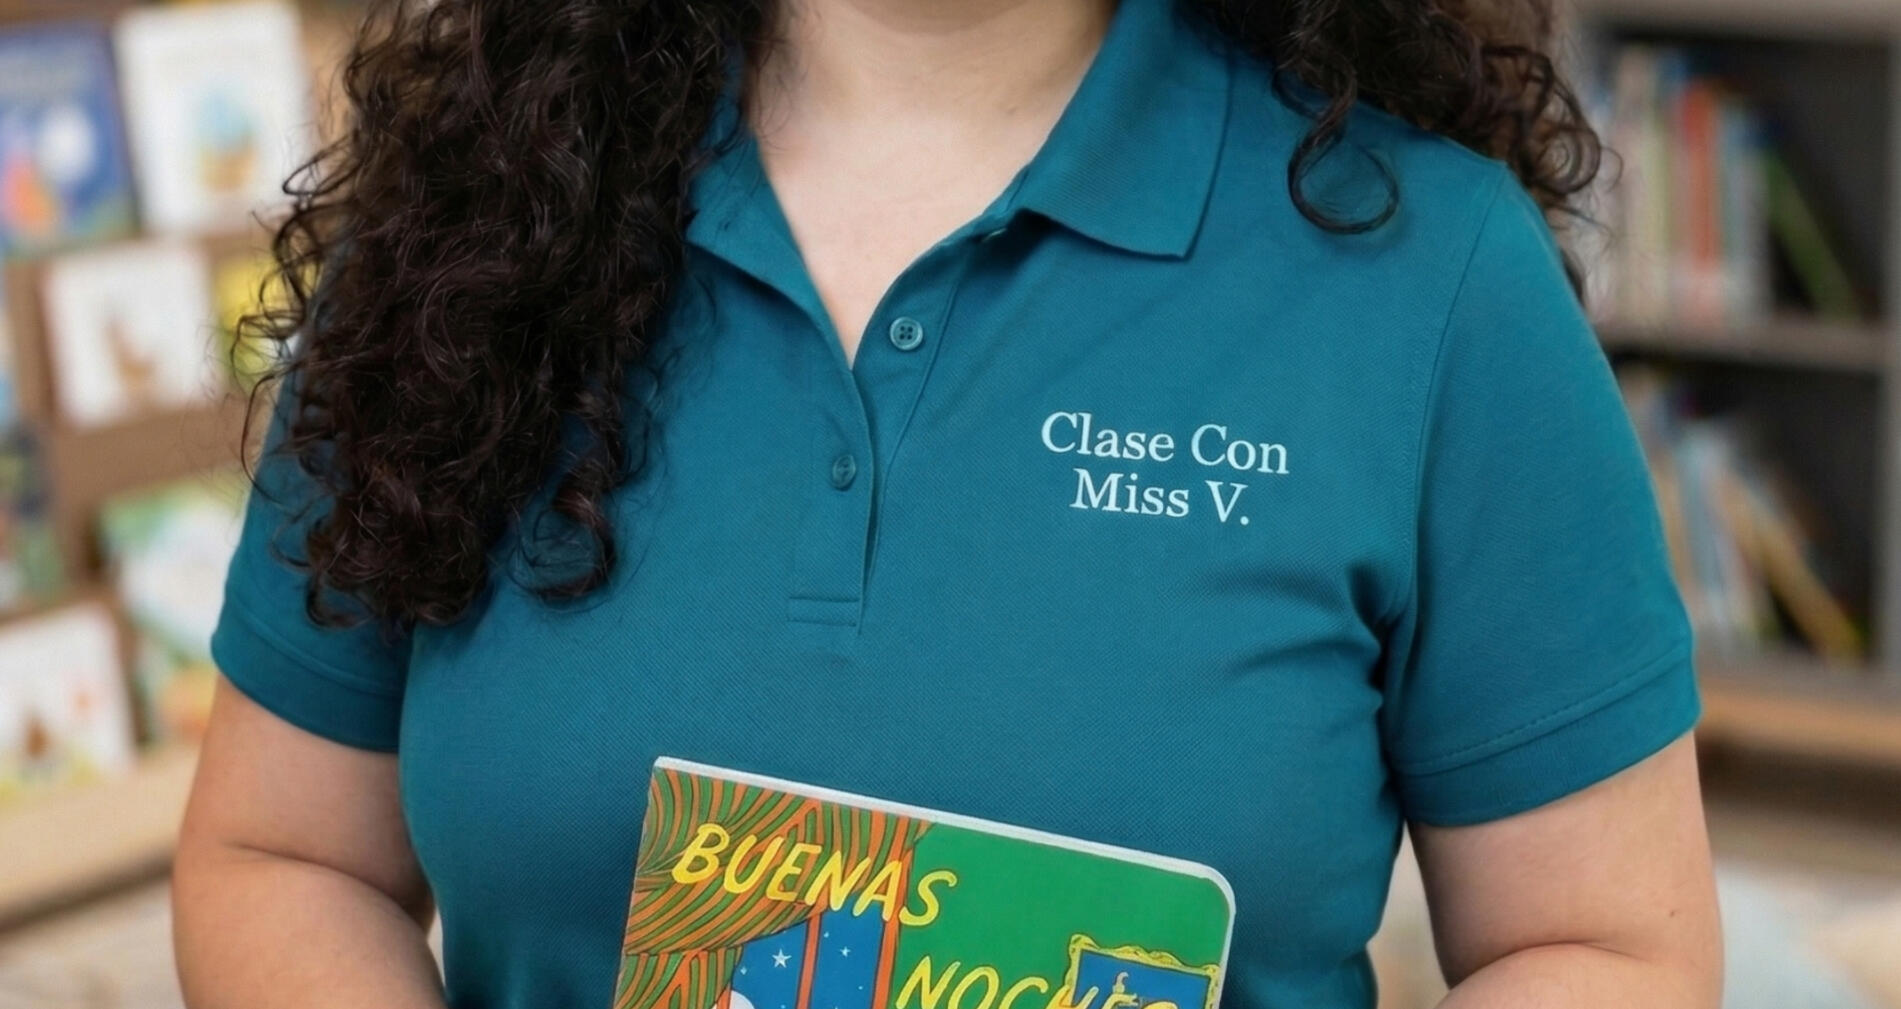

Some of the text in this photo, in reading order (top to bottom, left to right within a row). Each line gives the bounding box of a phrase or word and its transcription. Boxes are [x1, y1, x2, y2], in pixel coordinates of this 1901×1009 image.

[1041, 411, 1290, 475] Clase Con
[1069, 468, 1250, 526] Miss V.
[671, 823, 958, 927] BUENAS
[896, 955, 1178, 1009] NOC
